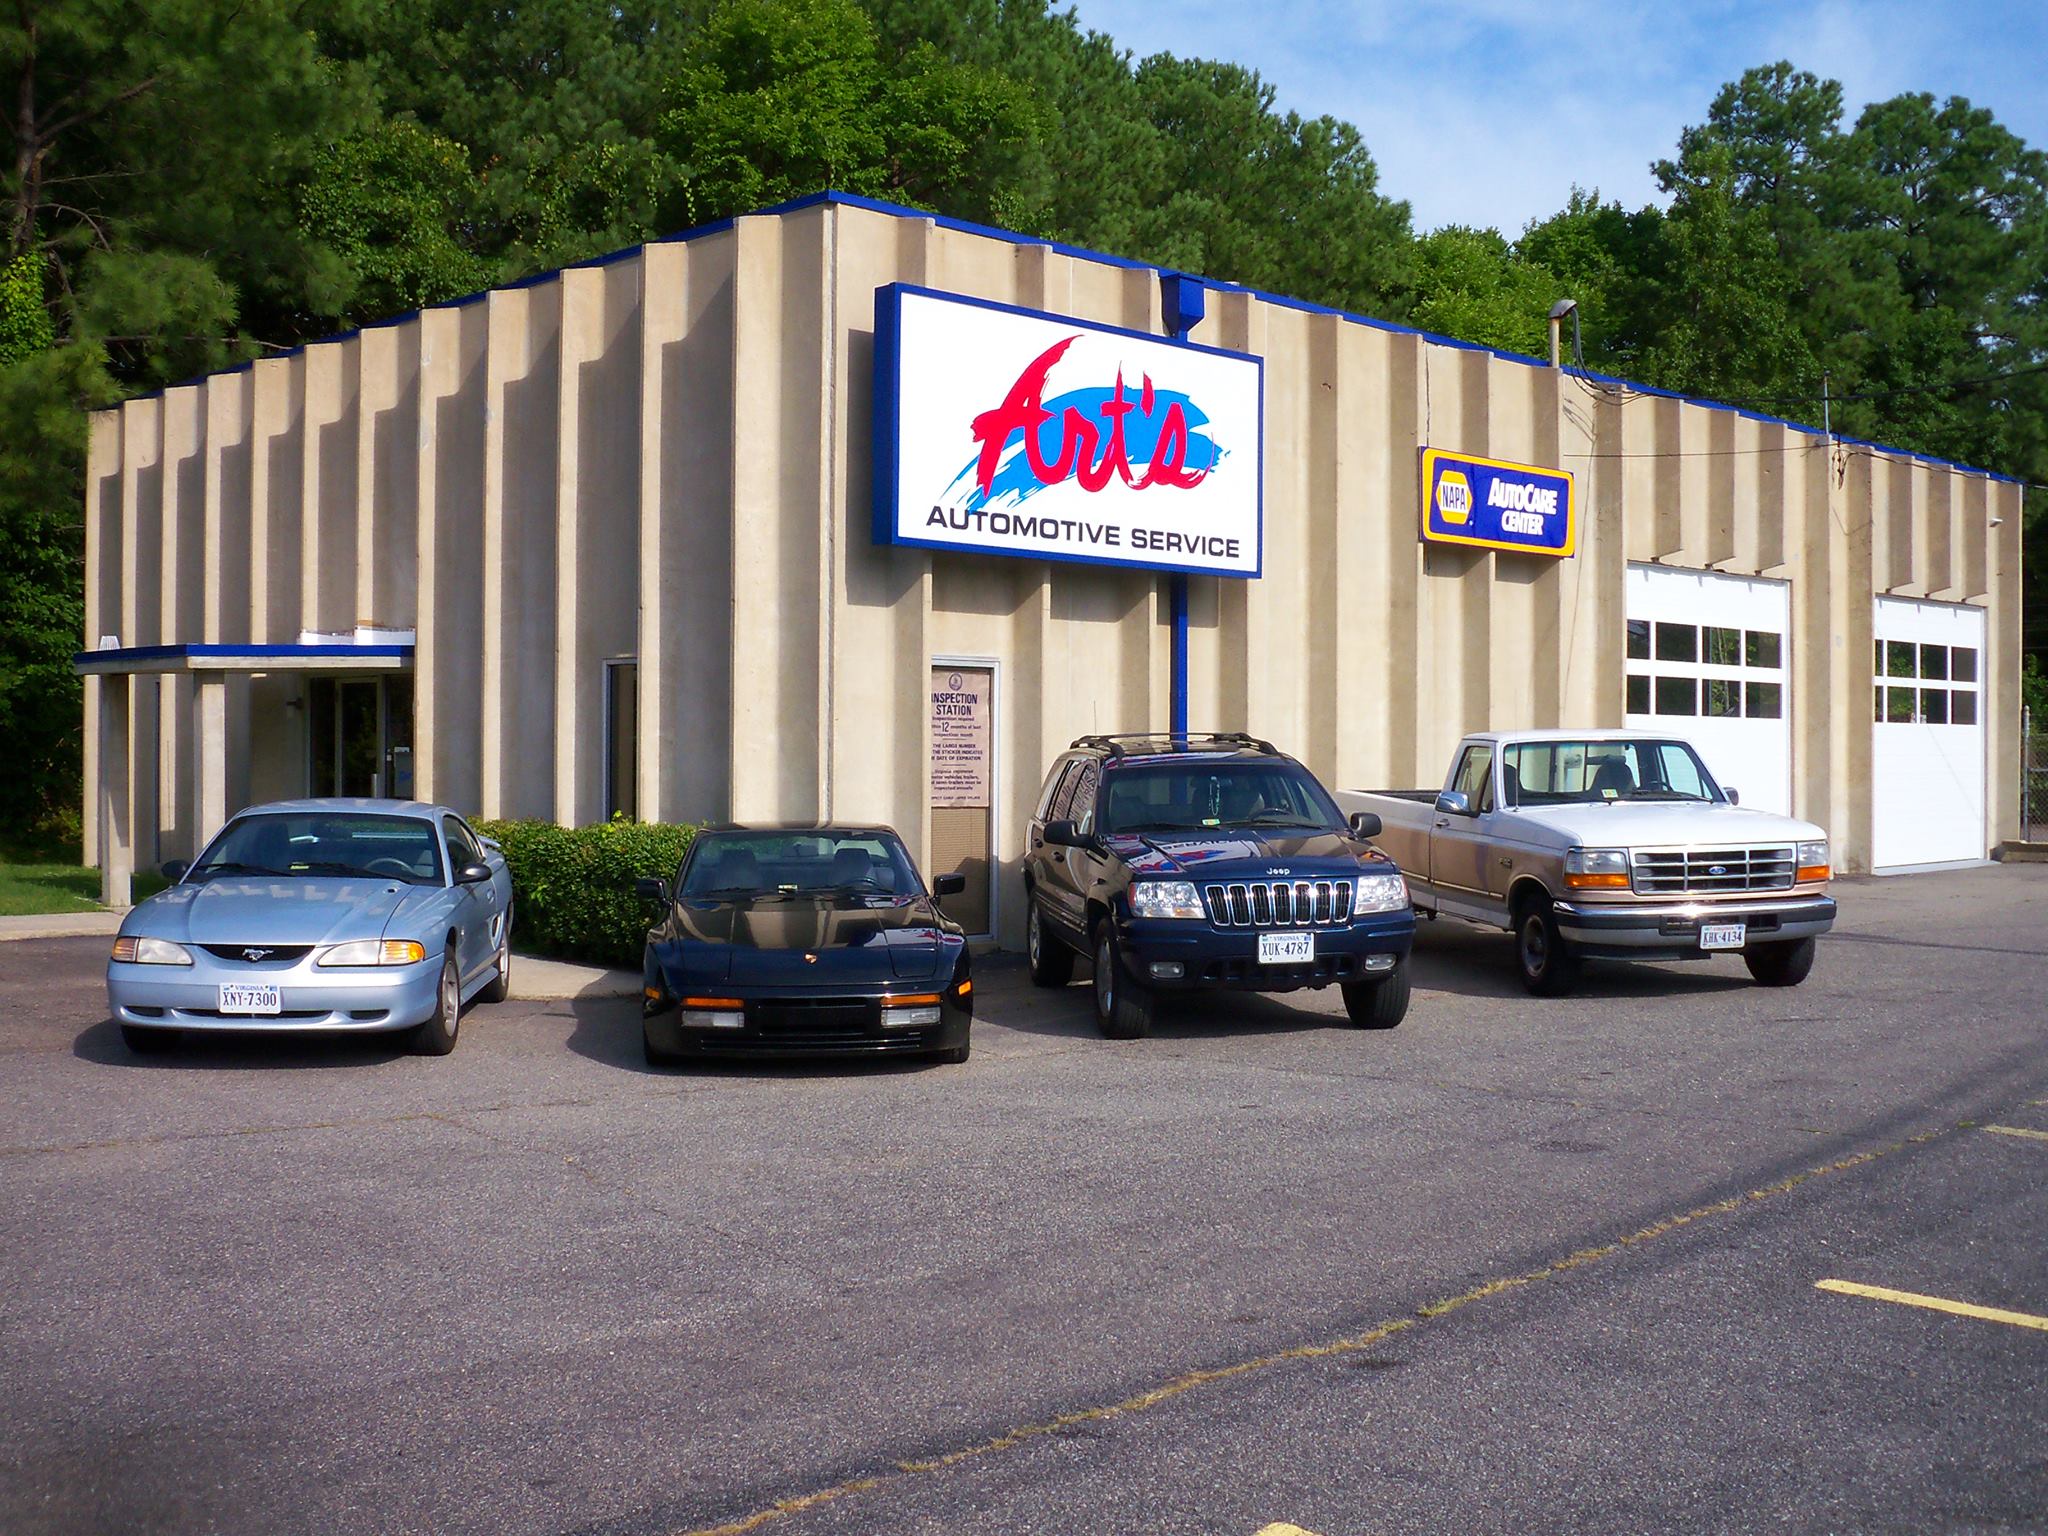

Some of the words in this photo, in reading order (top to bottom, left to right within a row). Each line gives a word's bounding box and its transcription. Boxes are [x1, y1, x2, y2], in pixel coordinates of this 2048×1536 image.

[970, 334, 1215, 499] Art's
[1442, 485, 1467, 511] NAPA
[926, 505, 1121, 546] AUTOMOTIVE
[1131, 528, 1240, 559] SERVICE
[936, 704, 972, 716] STATION
[941, 721, 950, 733] 12
[1265, 867, 1290, 875] Jeep
[1262, 941, 1310, 956] XUK-4787
[223, 991, 277, 1006] XNY-7300
